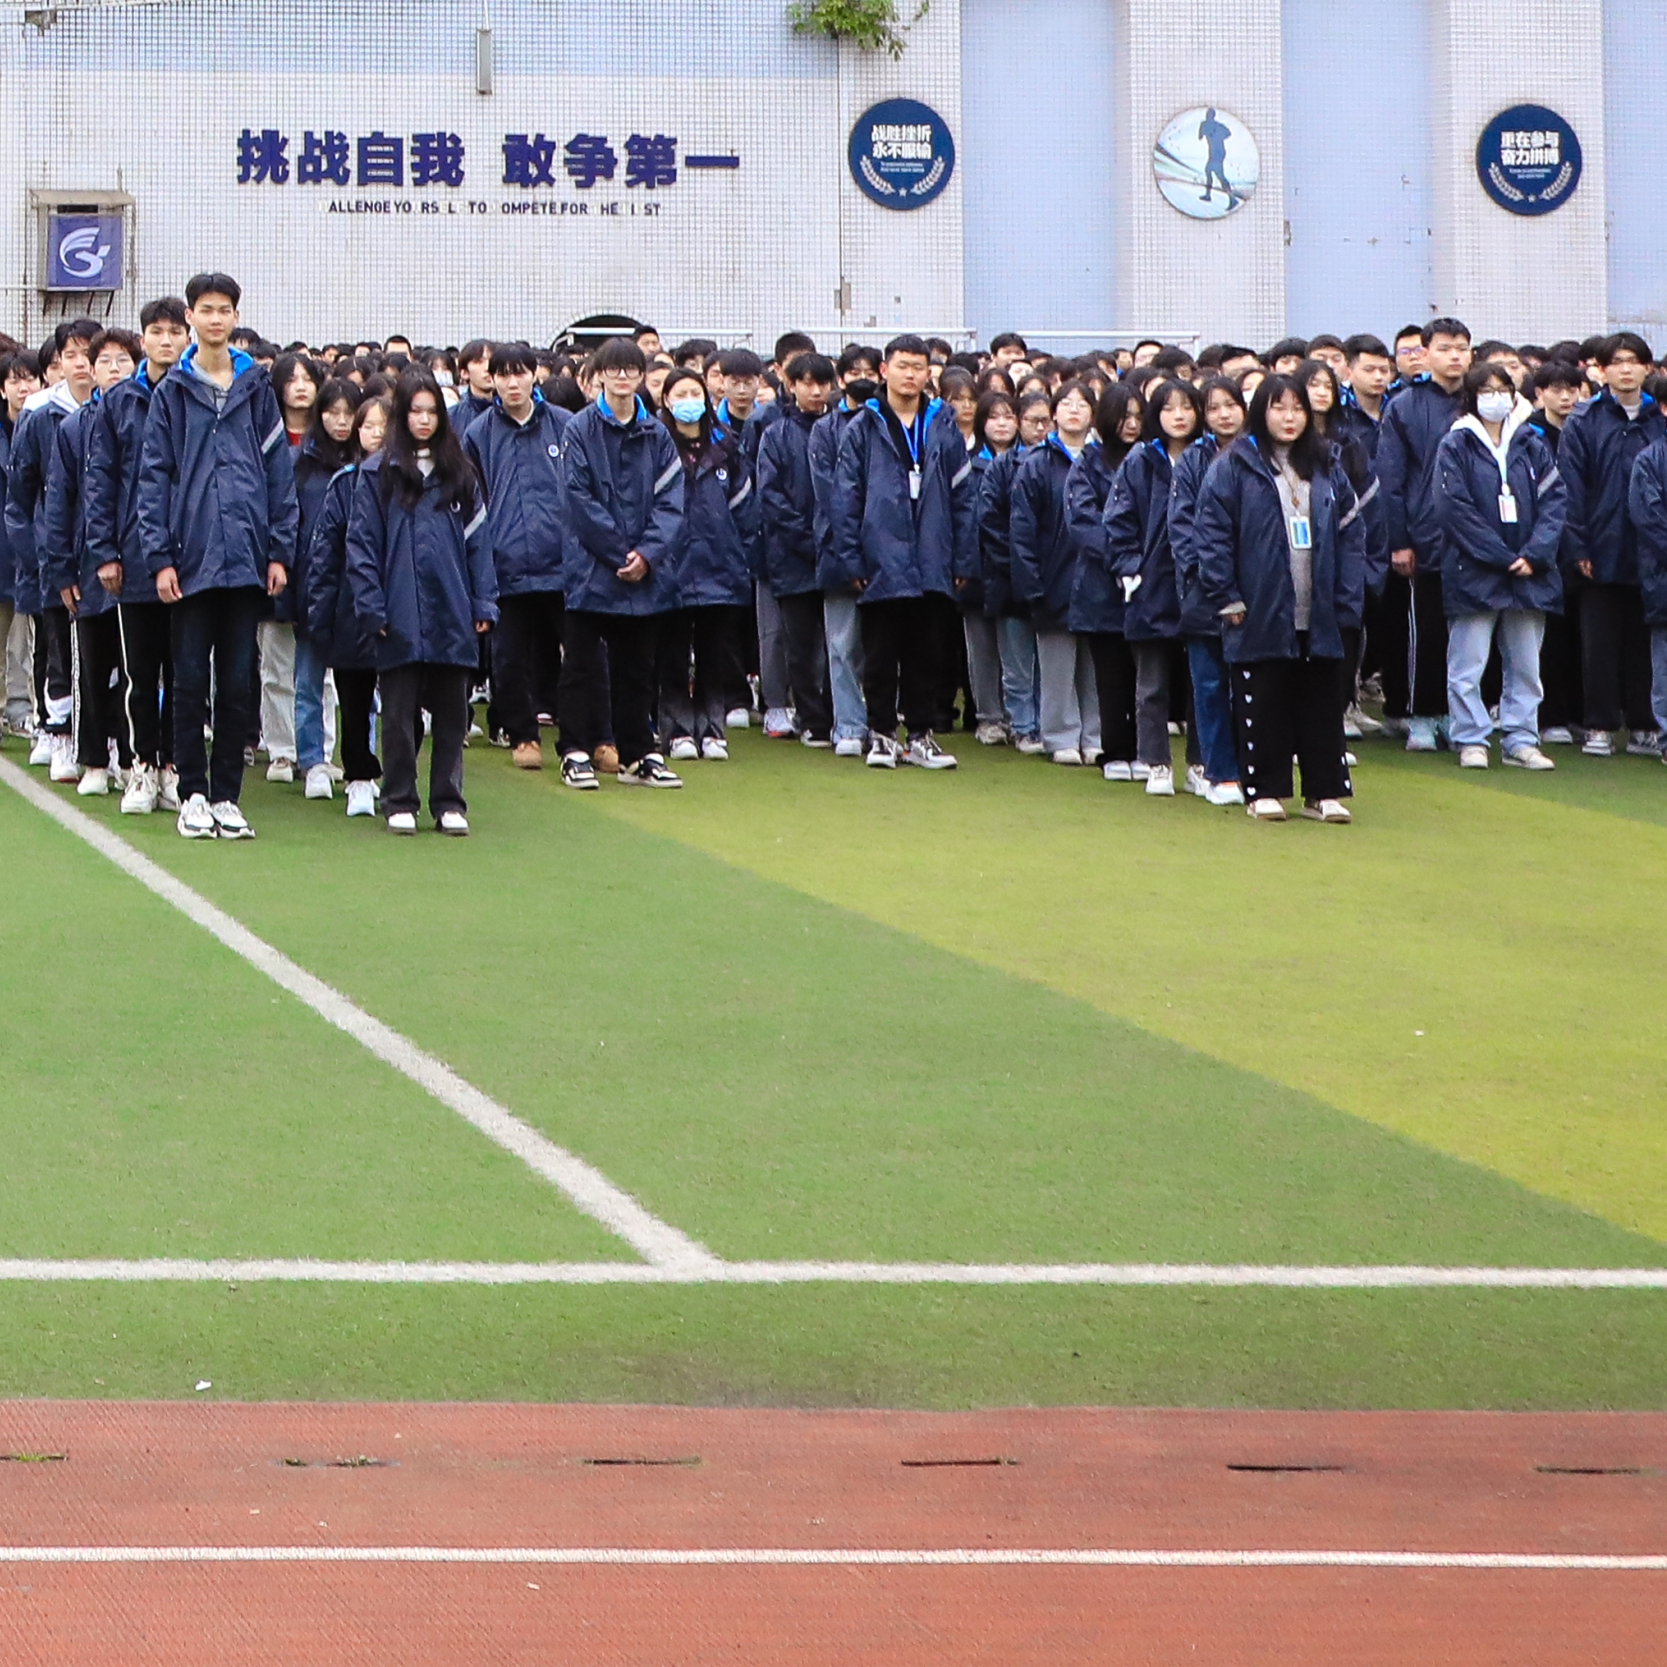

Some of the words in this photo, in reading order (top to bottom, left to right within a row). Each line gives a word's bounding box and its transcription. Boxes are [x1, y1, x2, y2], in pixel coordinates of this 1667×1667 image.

[237, 128, 466, 187] 挑战自我
[502, 133, 740, 189] 敢争第一
[319, 199, 391, 214] ALLENGE
[468, 200, 488, 215] TO
[496, 200, 558, 215] OMPETE
[560, 201, 588, 215] FOR
[596, 201, 619, 215] HE
